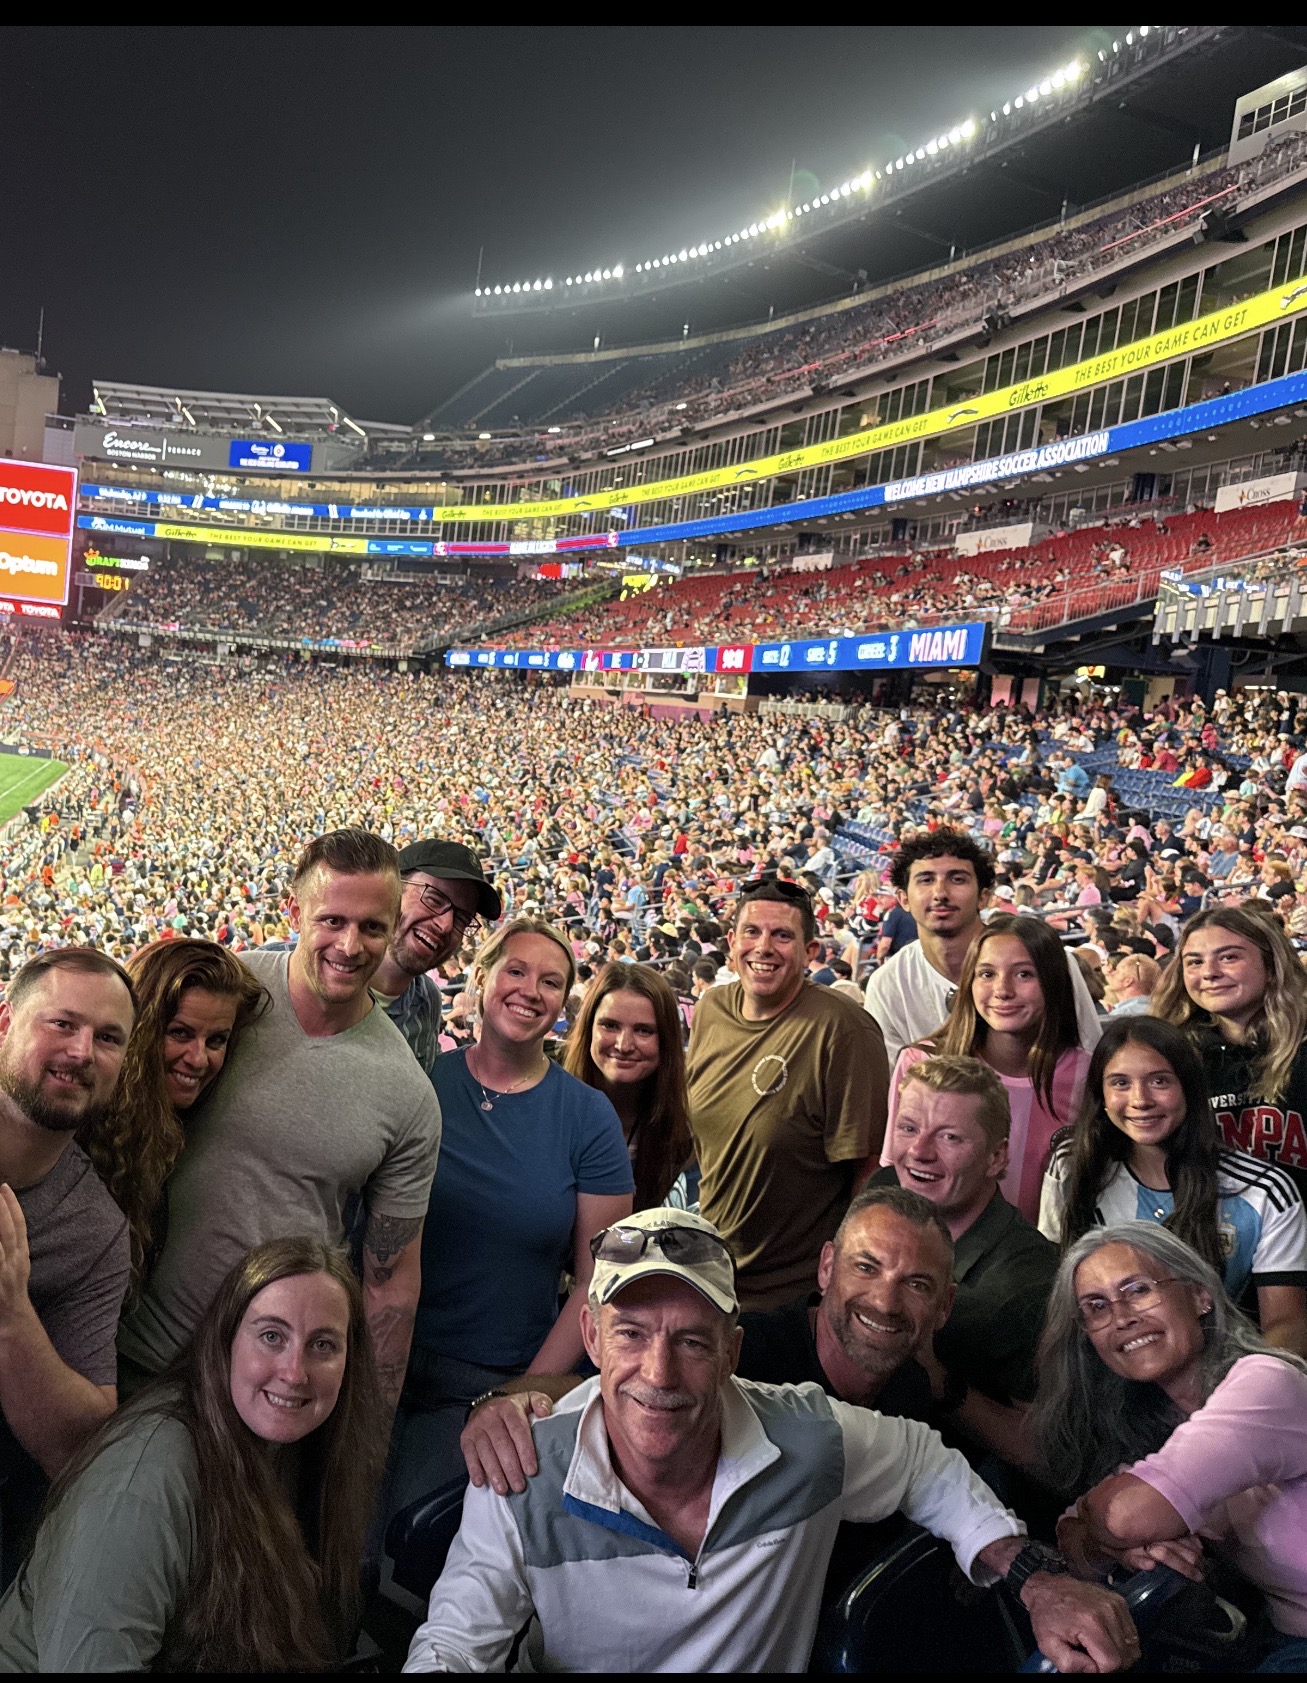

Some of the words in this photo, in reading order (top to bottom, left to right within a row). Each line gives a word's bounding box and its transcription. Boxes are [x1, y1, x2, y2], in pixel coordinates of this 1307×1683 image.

[1074, 370, 1092, 384] THE
[1095, 358, 1119, 374] BEST
[1121, 345, 1151, 367] YOUR
[1154, 331, 1189, 355] GAME
[1192, 319, 1221, 342] CAN
[1224, 308, 1248, 331] GET
[1008, 377, 1049, 407] Gillette
[103, 431, 162, 453] Encore
[821, 448, 834, 457] THE
[835, 442, 851, 455] BEST
[852, 436, 871, 449] YOUR
[872, 430, 893, 444] GAME
[895, 424, 910, 437] CAN
[913, 419, 928, 433] GET
[885, 478, 926, 502] WELCOME
[926, 473, 945, 493] NEW
[945, 459, 1000, 489] HAMPSHIRE
[998, 451, 1038, 475] SOCCER
[1038, 431, 1109, 467] ASSOCIATION
[0, 486, 68, 511] TOYOTA
[225, 533, 241, 541] BEST
[243, 535, 262, 543] YOUR
[0, 552, 58, 576] Optum
[20, 604, 61, 620] TOYOTA
[909, 629, 968, 662] MIAMI
